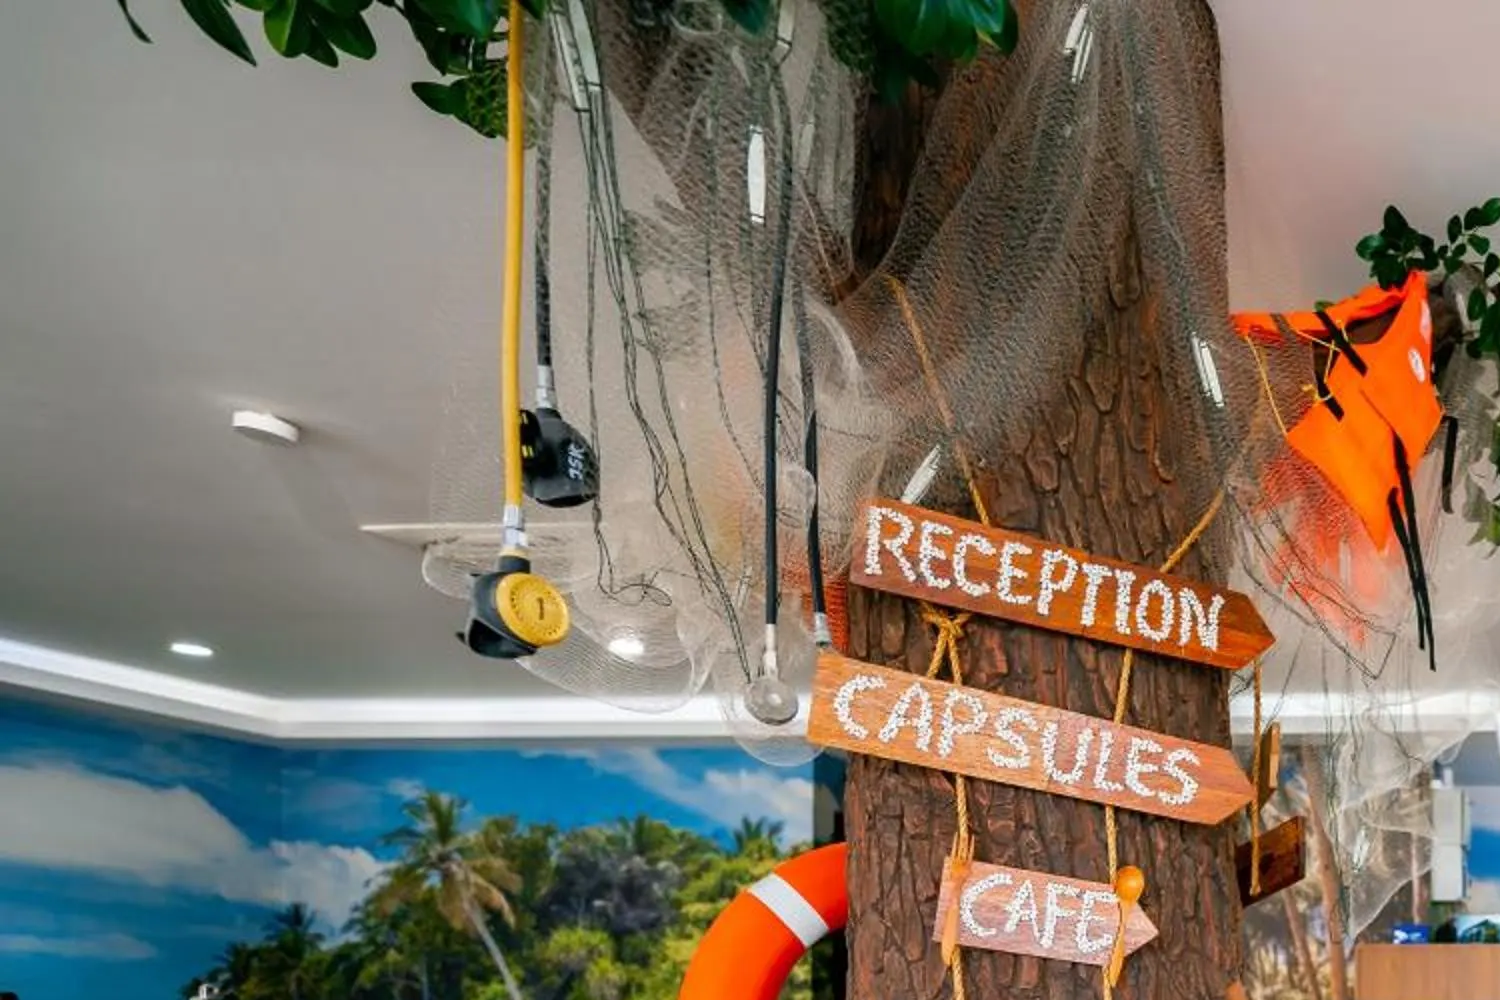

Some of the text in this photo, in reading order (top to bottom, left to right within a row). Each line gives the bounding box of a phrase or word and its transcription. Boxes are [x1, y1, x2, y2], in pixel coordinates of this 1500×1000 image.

[865, 506, 1225, 652] RECEPTION
[833, 674, 1201, 805] CAPSULES
[960, 873, 1121, 953] CAFE
